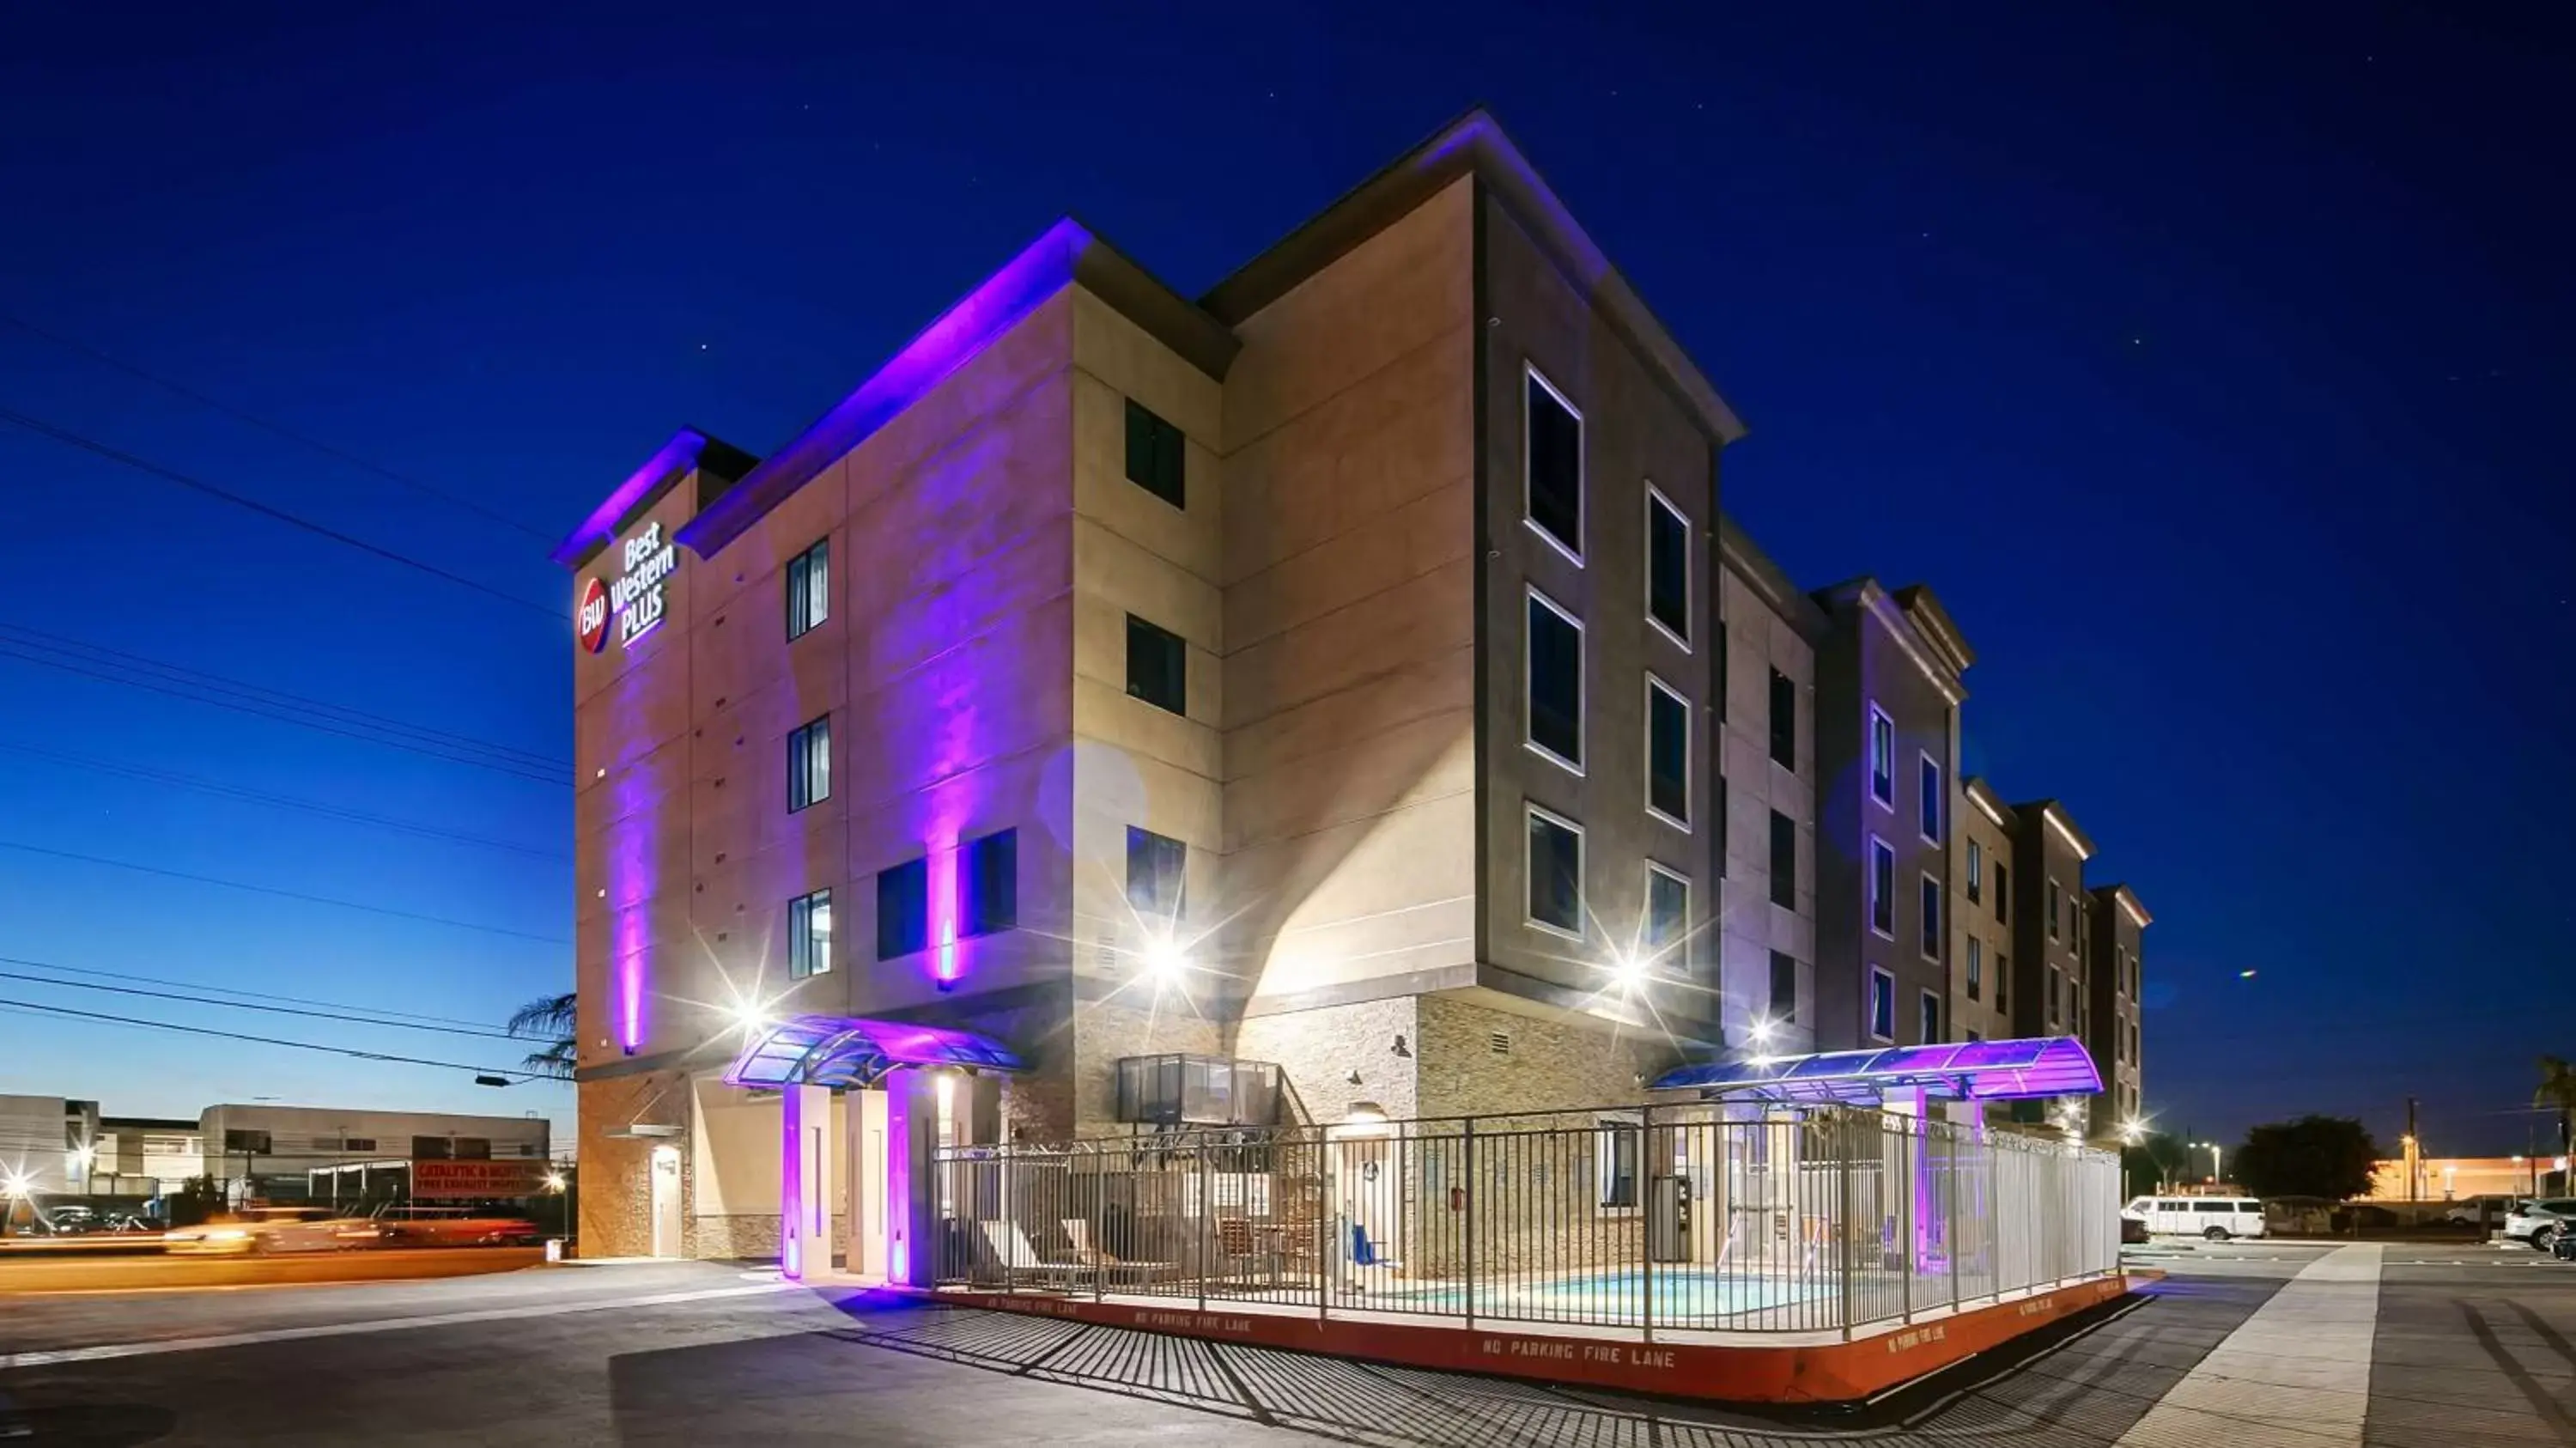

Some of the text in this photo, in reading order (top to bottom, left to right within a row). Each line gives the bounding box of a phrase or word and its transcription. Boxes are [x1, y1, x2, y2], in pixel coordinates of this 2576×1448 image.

[624, 521, 660, 573] Best
[611, 545, 674, 614] Western
[581, 594, 605, 636] BW
[622, 584, 663, 642] PLUS
[1151, 1313, 1191, 1328] PARKING
[1483, 1339, 1675, 1368] NO PARKING FIRE LANE
